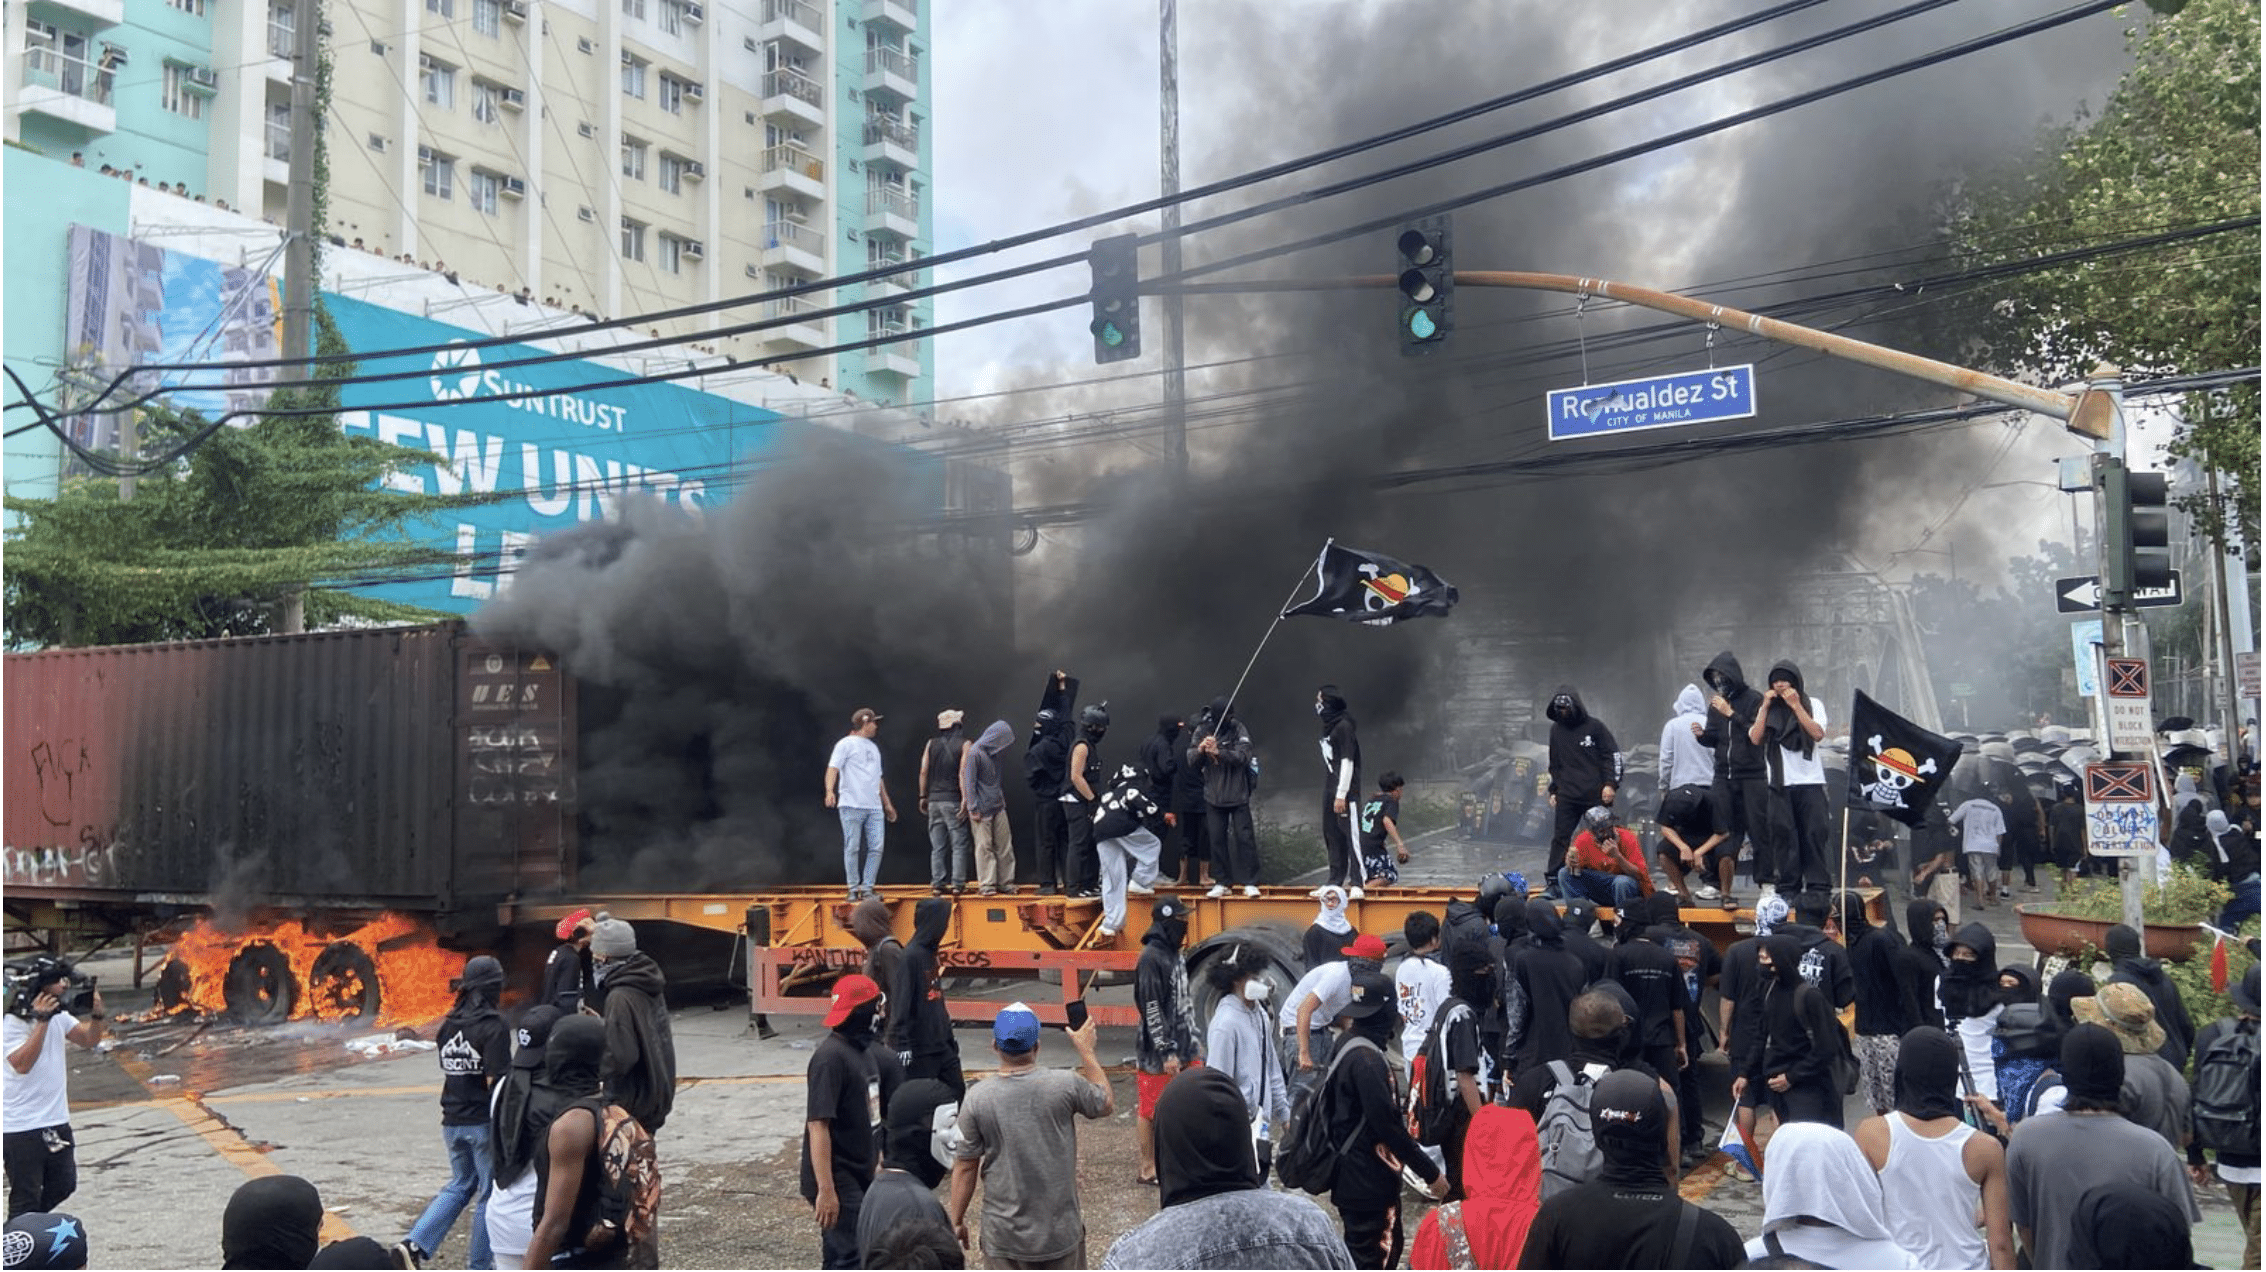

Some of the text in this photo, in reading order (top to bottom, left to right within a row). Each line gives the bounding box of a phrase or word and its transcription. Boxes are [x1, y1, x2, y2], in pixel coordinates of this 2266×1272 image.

[1711, 375, 1738, 400] St
[484, 369, 627, 433] SUNTRUST
[1606, 408, 1692, 427] CITY OF MANILA
[2114, 705, 2144, 716] DO NOT
[2118, 721, 2142, 731] BLOCK
